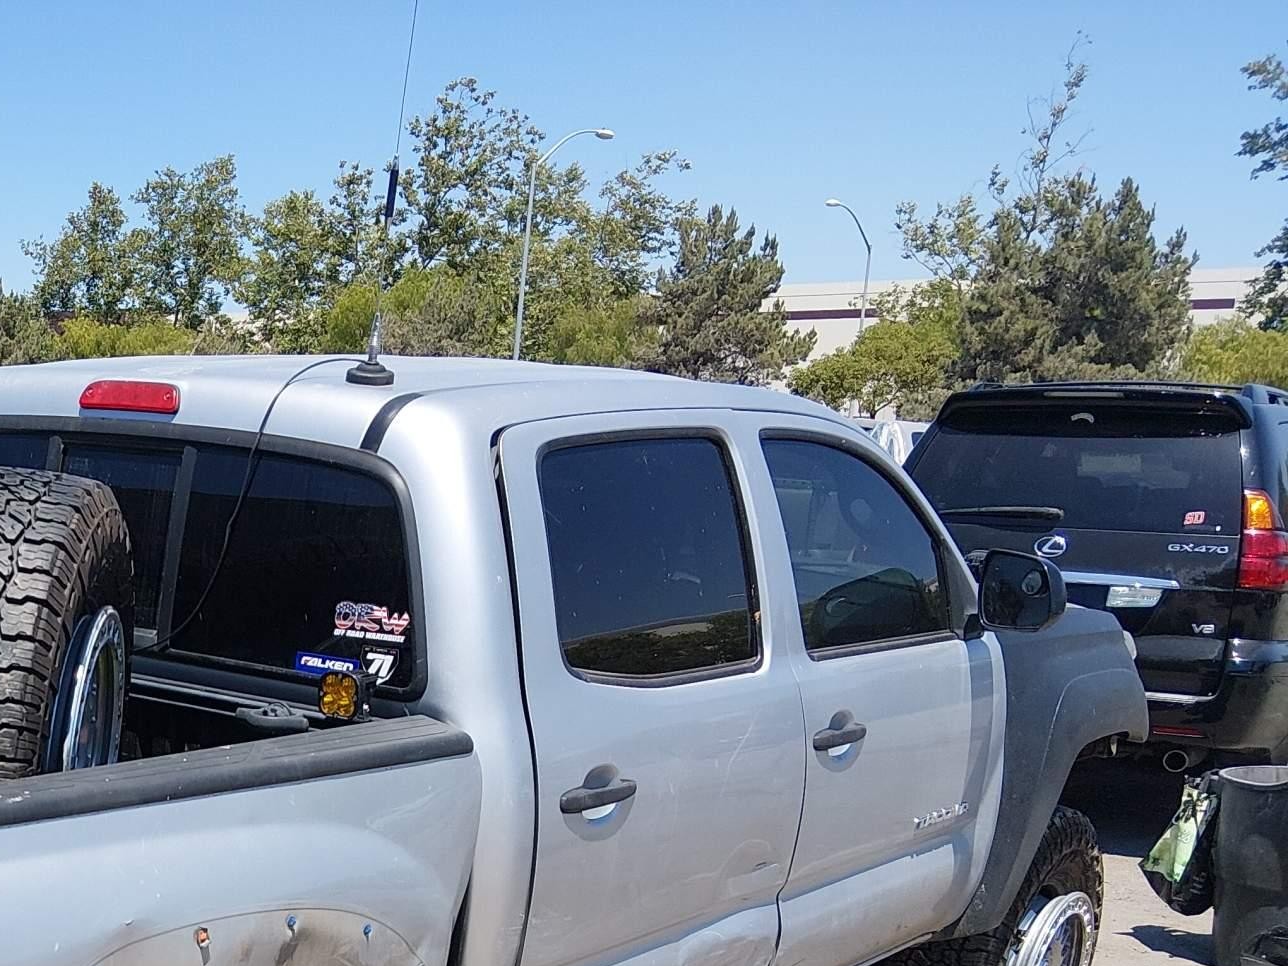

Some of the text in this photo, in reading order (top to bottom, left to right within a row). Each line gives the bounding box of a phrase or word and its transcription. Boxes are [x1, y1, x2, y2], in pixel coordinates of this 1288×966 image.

[1167, 543, 1230, 555] GX470
[334, 600, 412, 635] ORW
[1191, 623, 1216, 635] V8
[300, 655, 355, 672] FALKEN
